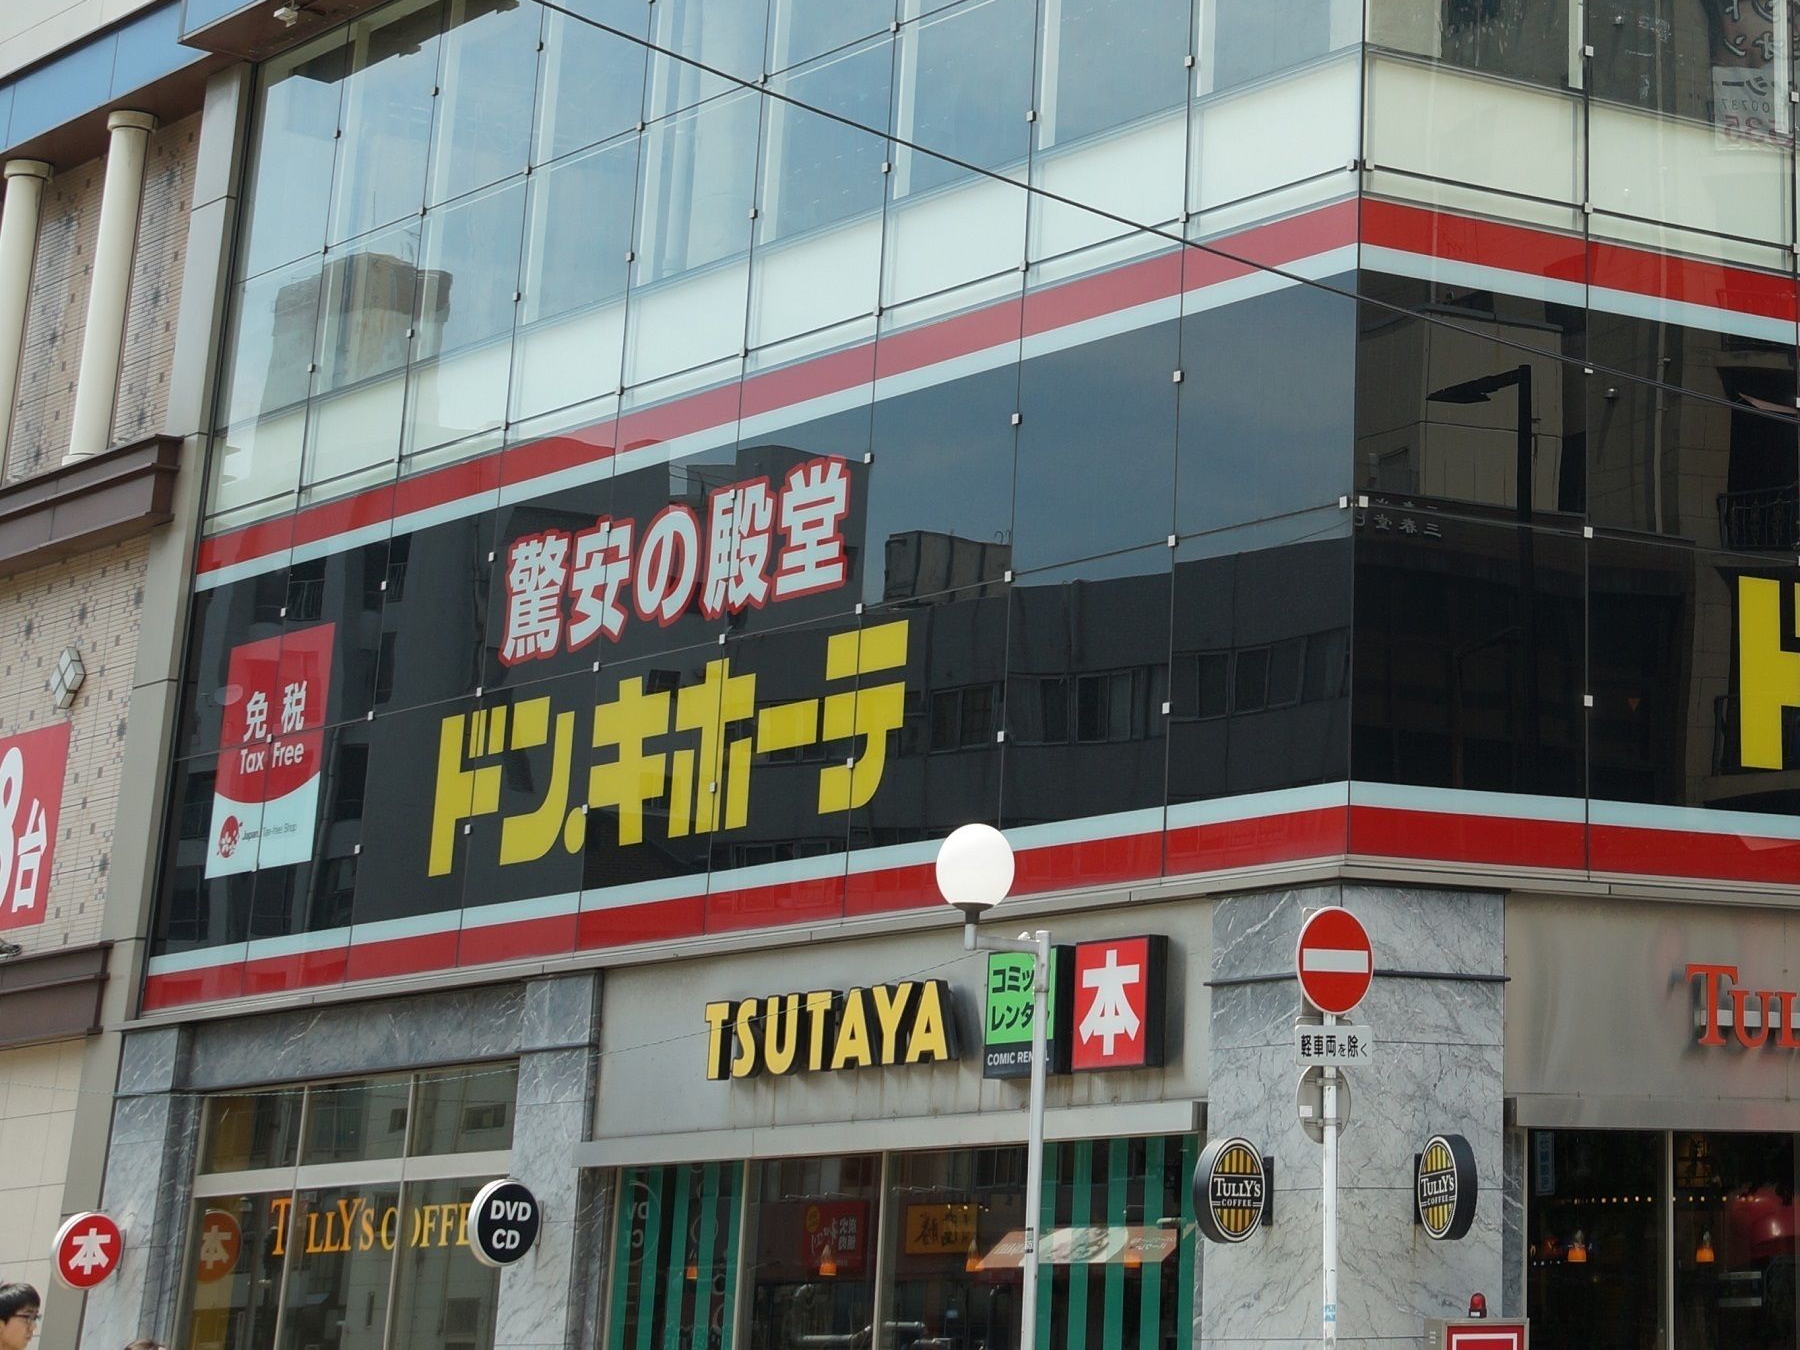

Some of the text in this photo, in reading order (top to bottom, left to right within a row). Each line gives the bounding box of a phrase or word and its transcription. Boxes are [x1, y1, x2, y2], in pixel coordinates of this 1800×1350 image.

[501, 459, 849, 663] 驚安の殿堂
[243, 679, 308, 743] 免税
[239, 740, 305, 777] Tax Free
[991, 964, 1036, 994] コミッ
[991, 1001, 1050, 1032] レンタ
[1078, 948, 1141, 1057] 本
[705, 978, 949, 1081] TSUTAYA
[987, 1051, 1015, 1066] COMIC
[1300, 1034, 1369, 1059] 軽車両を除く
[490, 1199, 533, 1223] DVD
[1221, 1197, 1253, 1208] COFFEE
[1427, 1193, 1450, 1207] COFFEE
[271, 1195, 376, 1256] TLLY's
[492, 1228, 521, 1251] CD
[71, 1227, 111, 1275] 本
